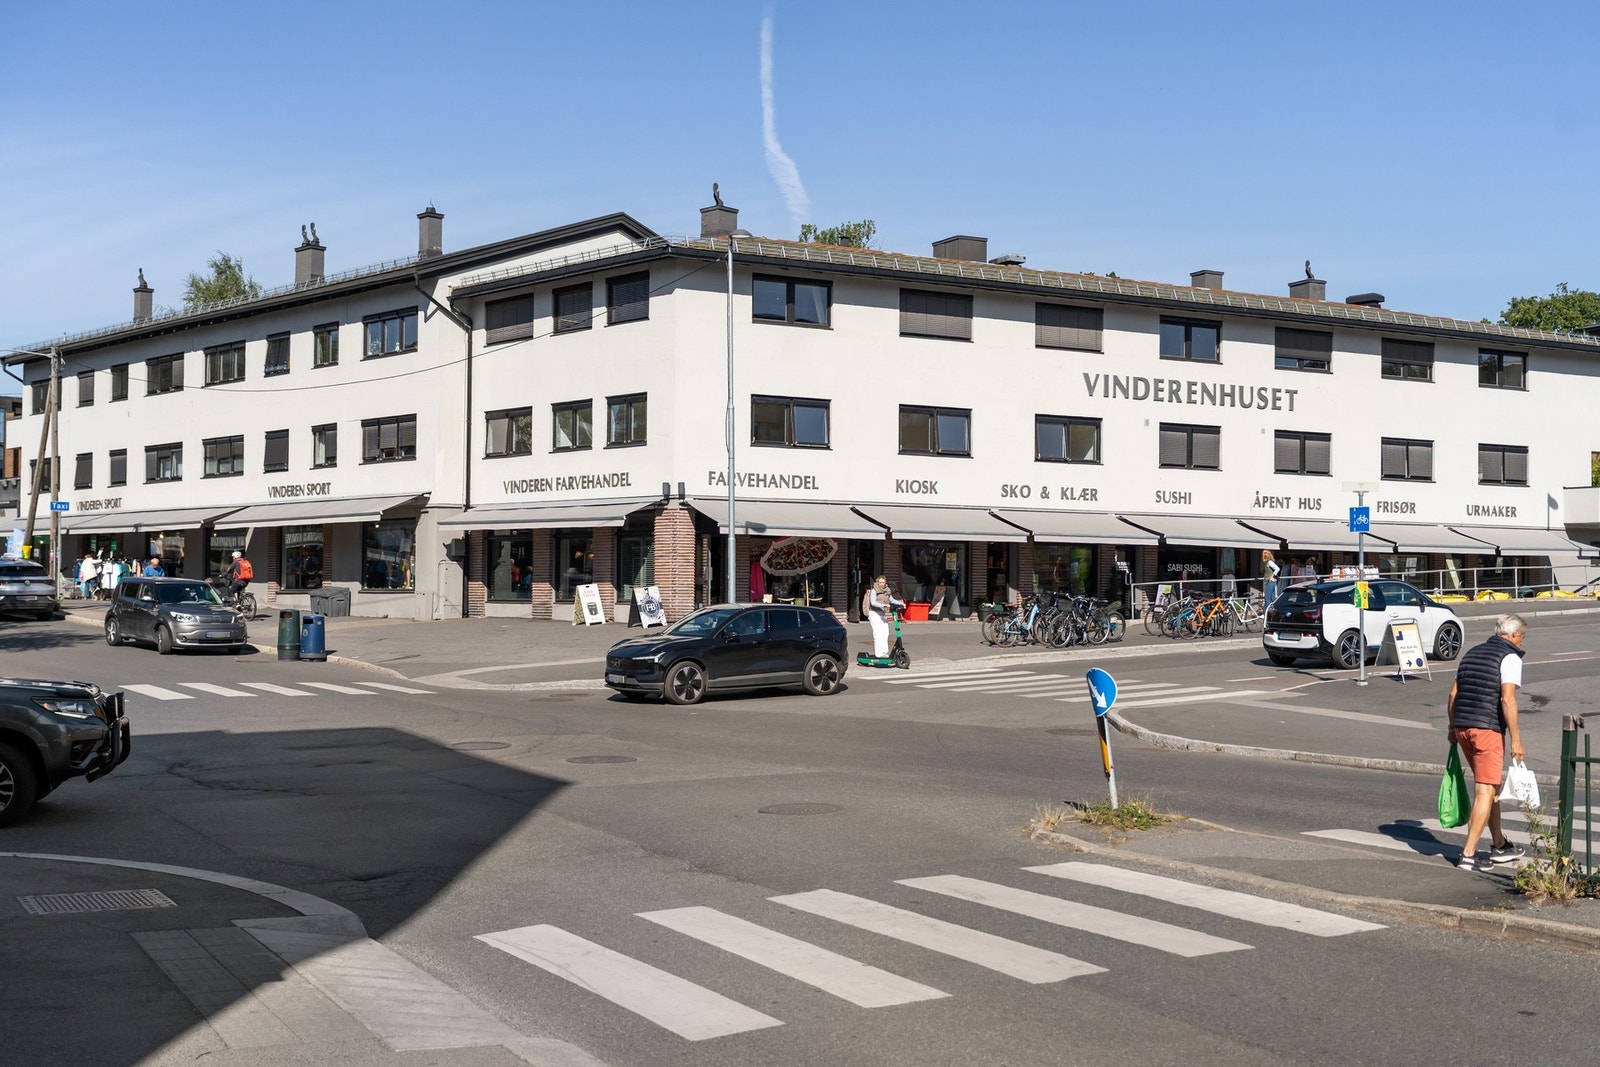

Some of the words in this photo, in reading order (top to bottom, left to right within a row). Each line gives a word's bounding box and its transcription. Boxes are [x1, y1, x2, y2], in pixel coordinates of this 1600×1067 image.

[1082, 372, 1299, 412] VINDERENHUSET
[268, 484, 306, 499] VINDEREN
[306, 482, 332, 497] SPORT
[504, 478, 553, 495] VINDEREN
[556, 472, 632, 490] FARVEHANDEL
[895, 479, 938, 495] KIOSK
[1001, 484, 1032, 499] SKO
[1040, 486, 1050, 500] &
[1060, 487, 1098, 502] KLÆR
[1155, 490, 1192, 505] SUSHI
[1253, 490, 1292, 510] ÅPENT
[1298, 497, 1322, 511] HUS
[52, 501, 69, 511] Taxi
[76, 499, 104, 512] VINDEREN
[104, 497, 122, 510] SPORT
[1376, 500, 1416, 514] FRISØR
[1466, 504, 1517, 518] URMAKER
[1167, 563, 1183, 572] SABI
[1183, 563, 1203, 572] SUSHI
